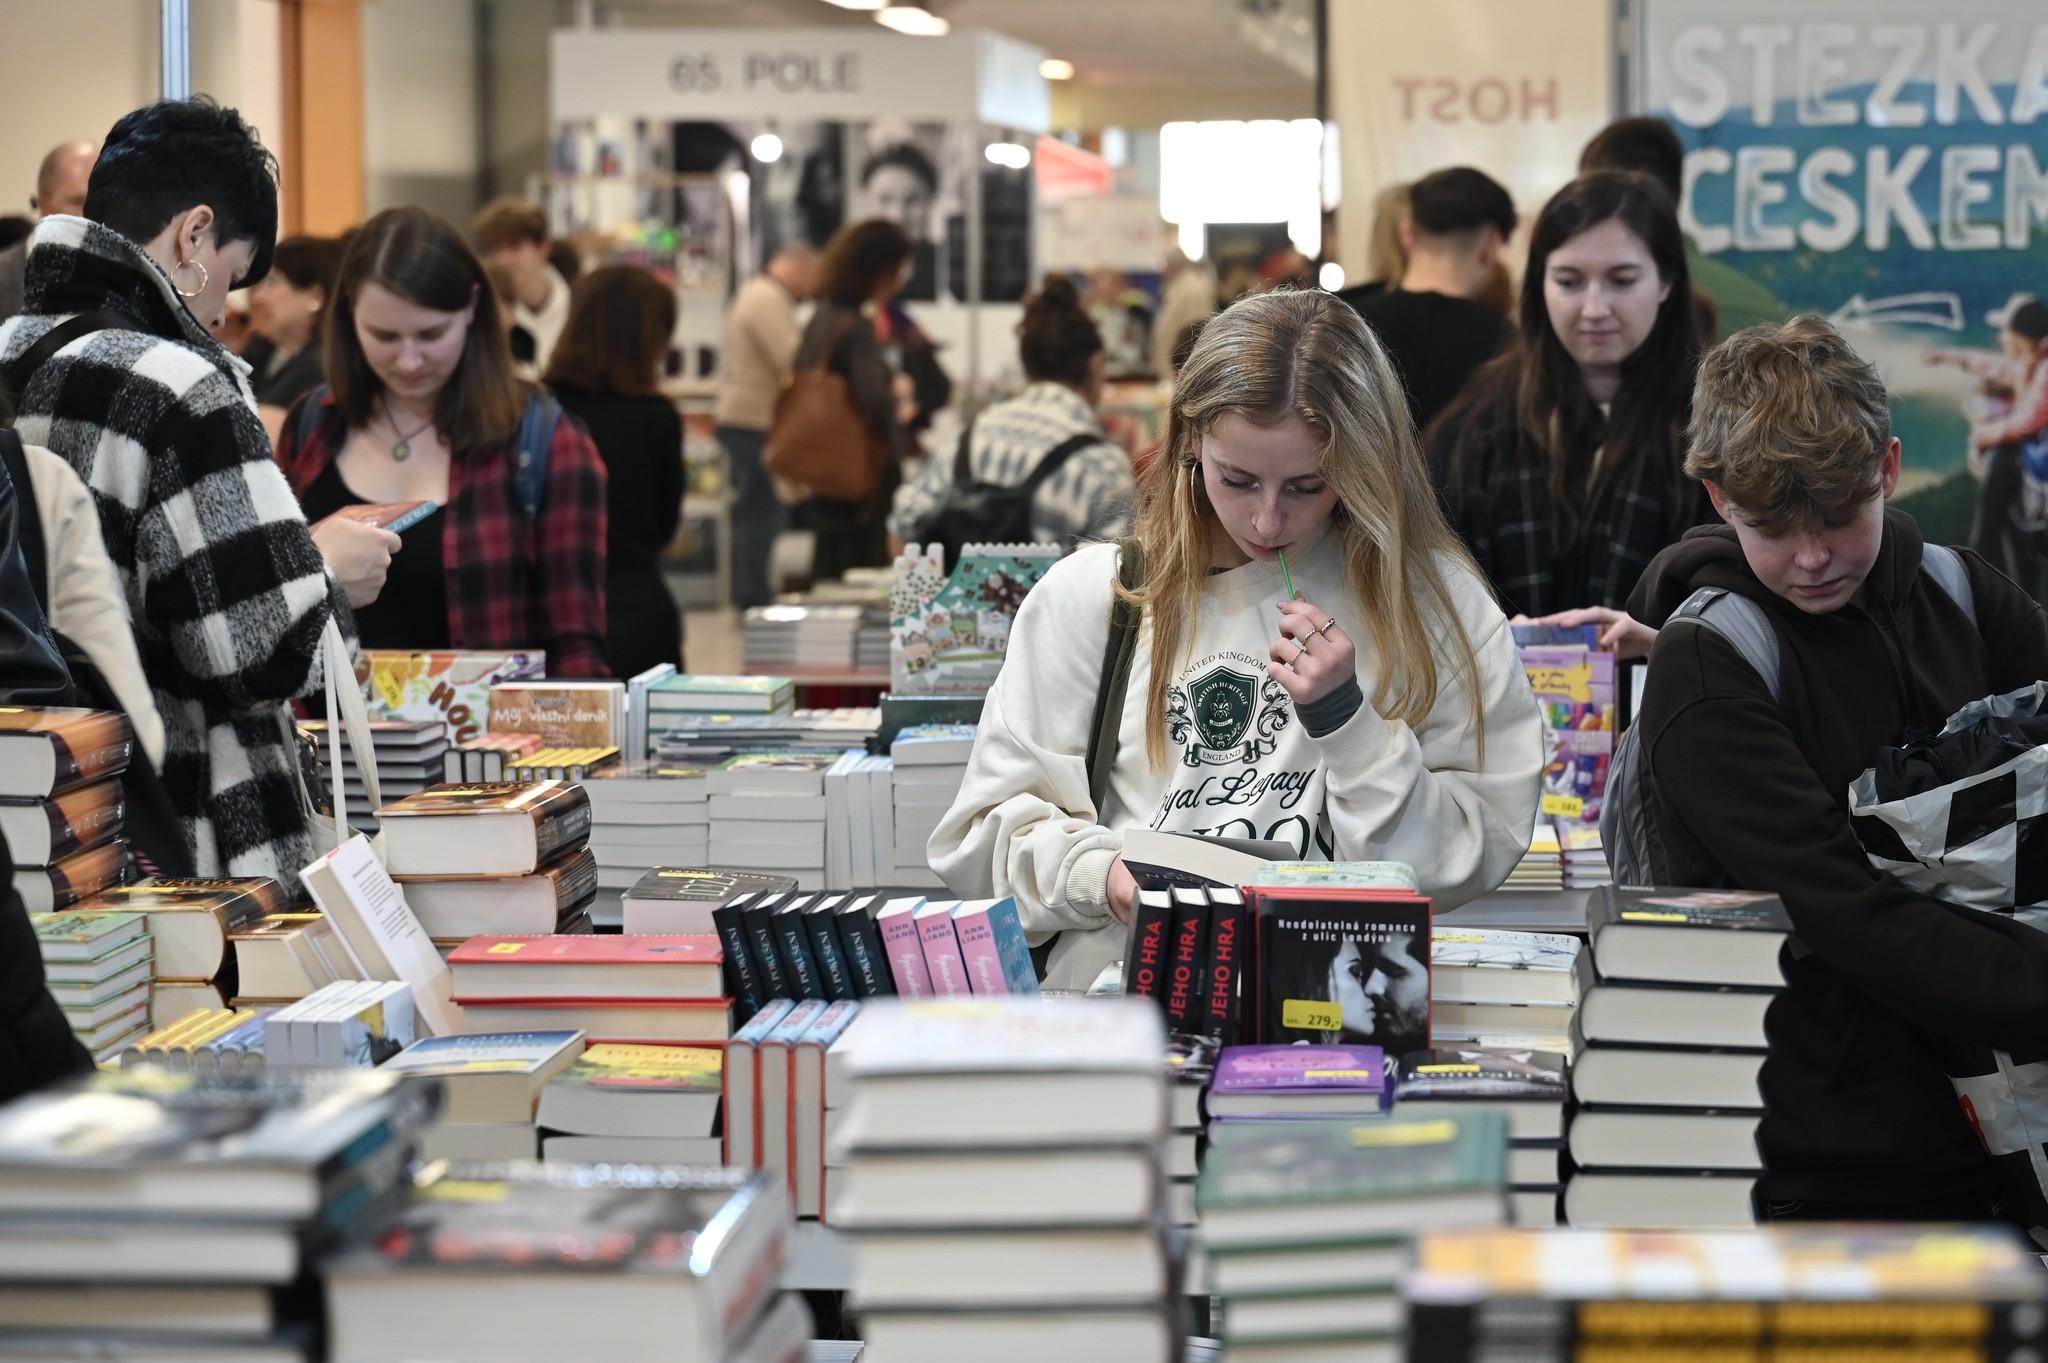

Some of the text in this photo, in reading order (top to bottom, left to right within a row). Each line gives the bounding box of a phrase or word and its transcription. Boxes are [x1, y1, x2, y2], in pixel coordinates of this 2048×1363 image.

[742, 51, 862, 95] POLE
[1179, 651, 1267, 682] UNITED KINGDOM
[1219, 682, 1248, 705] HERITAGE
[1202, 749, 1241, 761] ENGLAND
[1206, 768, 1317, 810] Legacy
[888, 922, 909, 934] ANN
[926, 923, 947, 934] ANN
[964, 925, 985, 935] ANN
[1278, 918, 1416, 933] Neodolatelná romance
[886, 929, 916, 942] LIANG
[923, 930, 953, 943] LIANG
[961, 932, 991, 945] LIANG
[1140, 920, 1162, 964] HRA
[1216, 917, 1235, 961] HRA
[1302, 931, 1391, 944] z ulic Londýna
[1169, 918, 1199, 1019] JEHO HRA
[1211, 965, 1231, 1019] JEHO
